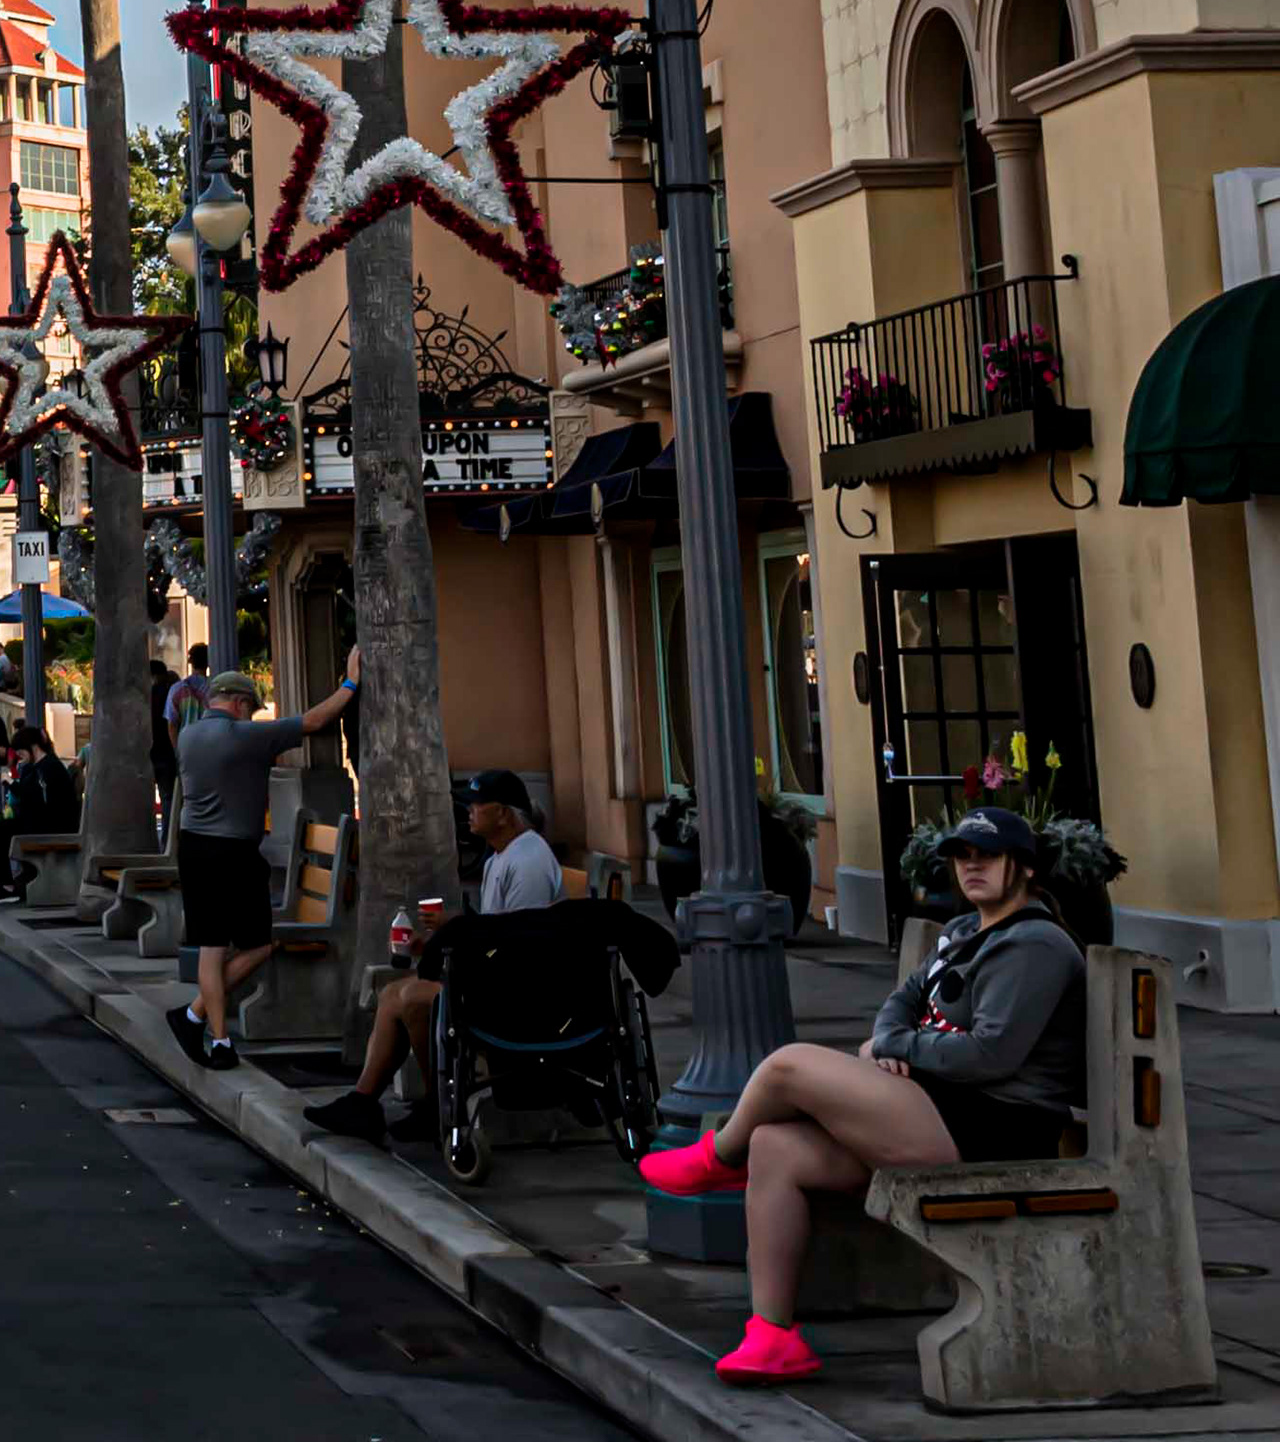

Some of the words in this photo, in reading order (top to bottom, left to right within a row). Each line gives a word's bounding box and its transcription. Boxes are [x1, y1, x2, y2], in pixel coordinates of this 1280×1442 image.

[421, 432, 490, 456] UPON
[422, 458, 441, 482] A
[455, 457, 514, 481] TIME
[17, 541, 45, 557] TAXI
